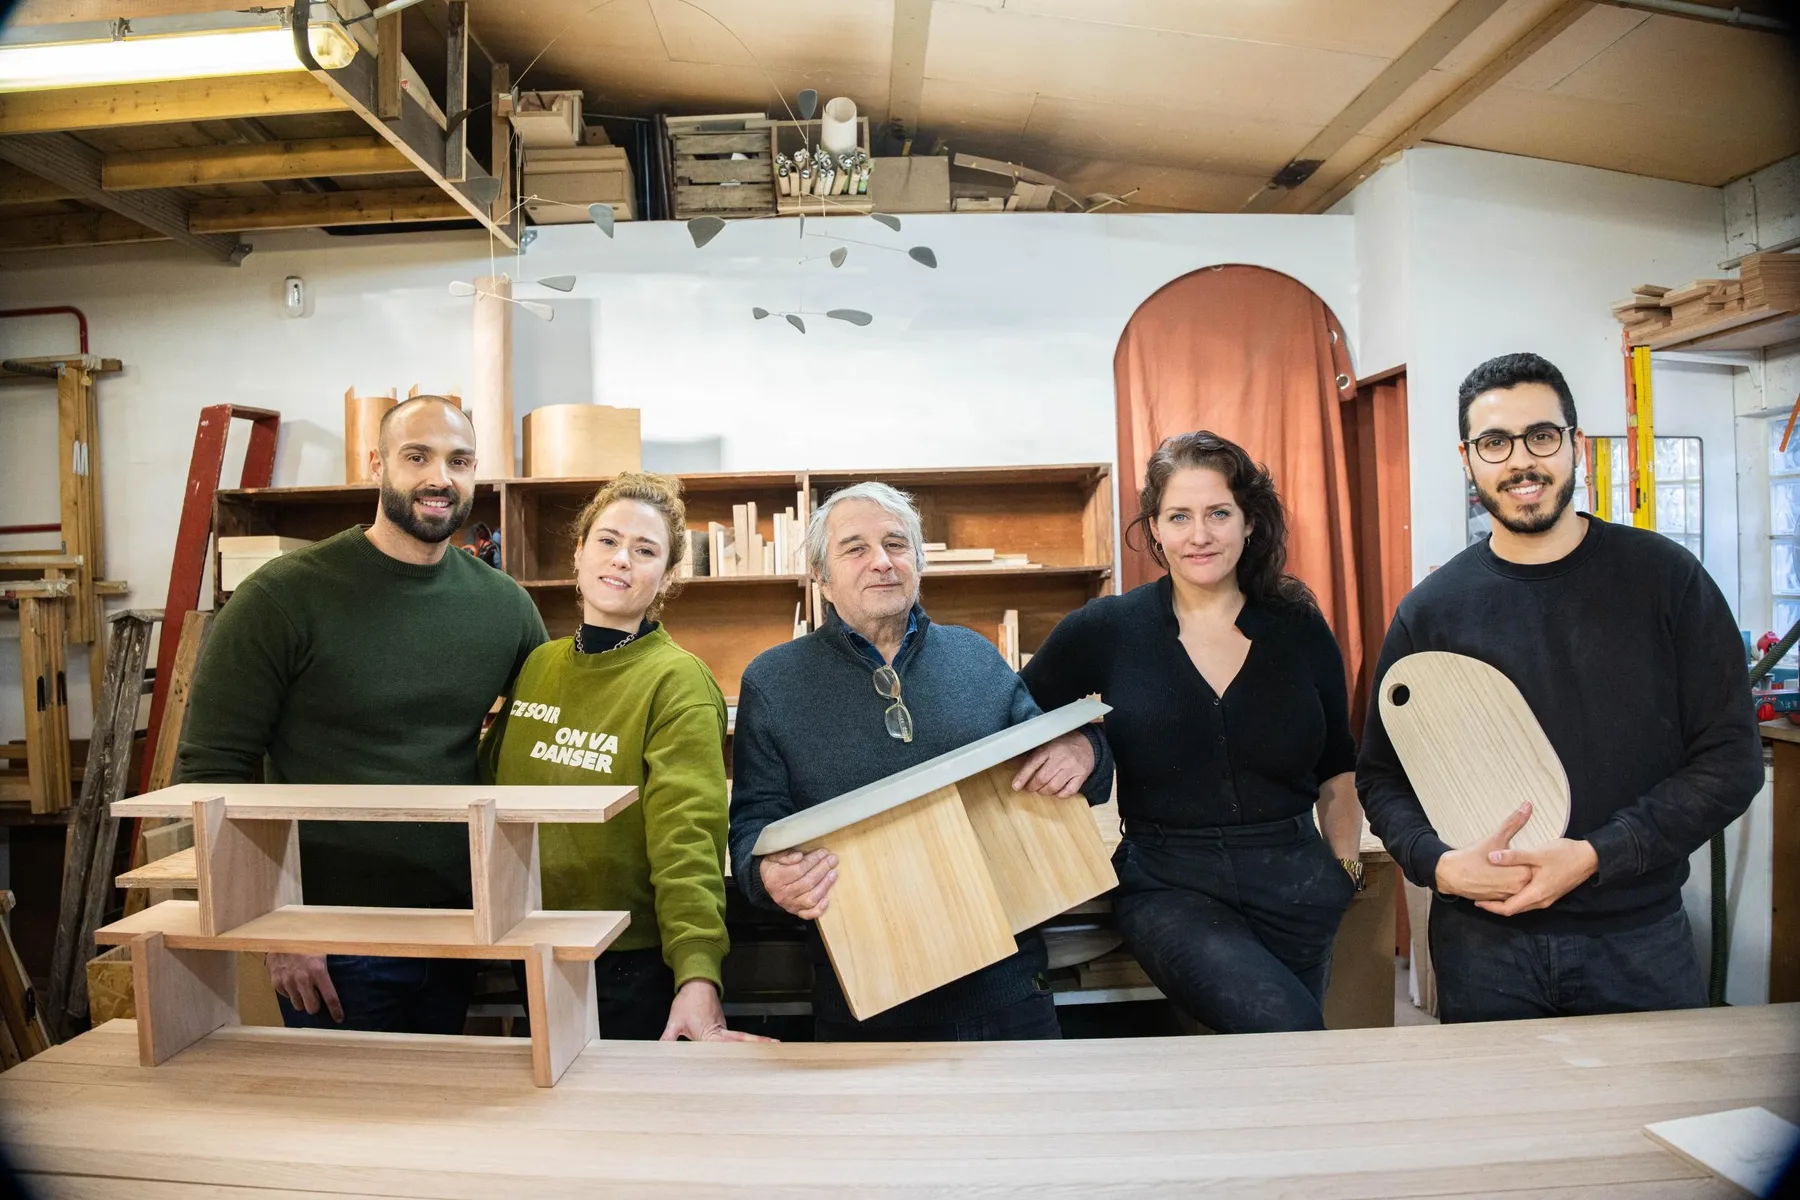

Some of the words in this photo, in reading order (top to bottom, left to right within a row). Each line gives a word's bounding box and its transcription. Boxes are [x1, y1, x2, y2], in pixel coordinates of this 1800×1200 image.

[555, 727, 588, 748] ON
[588, 732, 618, 754] VA
[530, 741, 613, 774] DANSER
